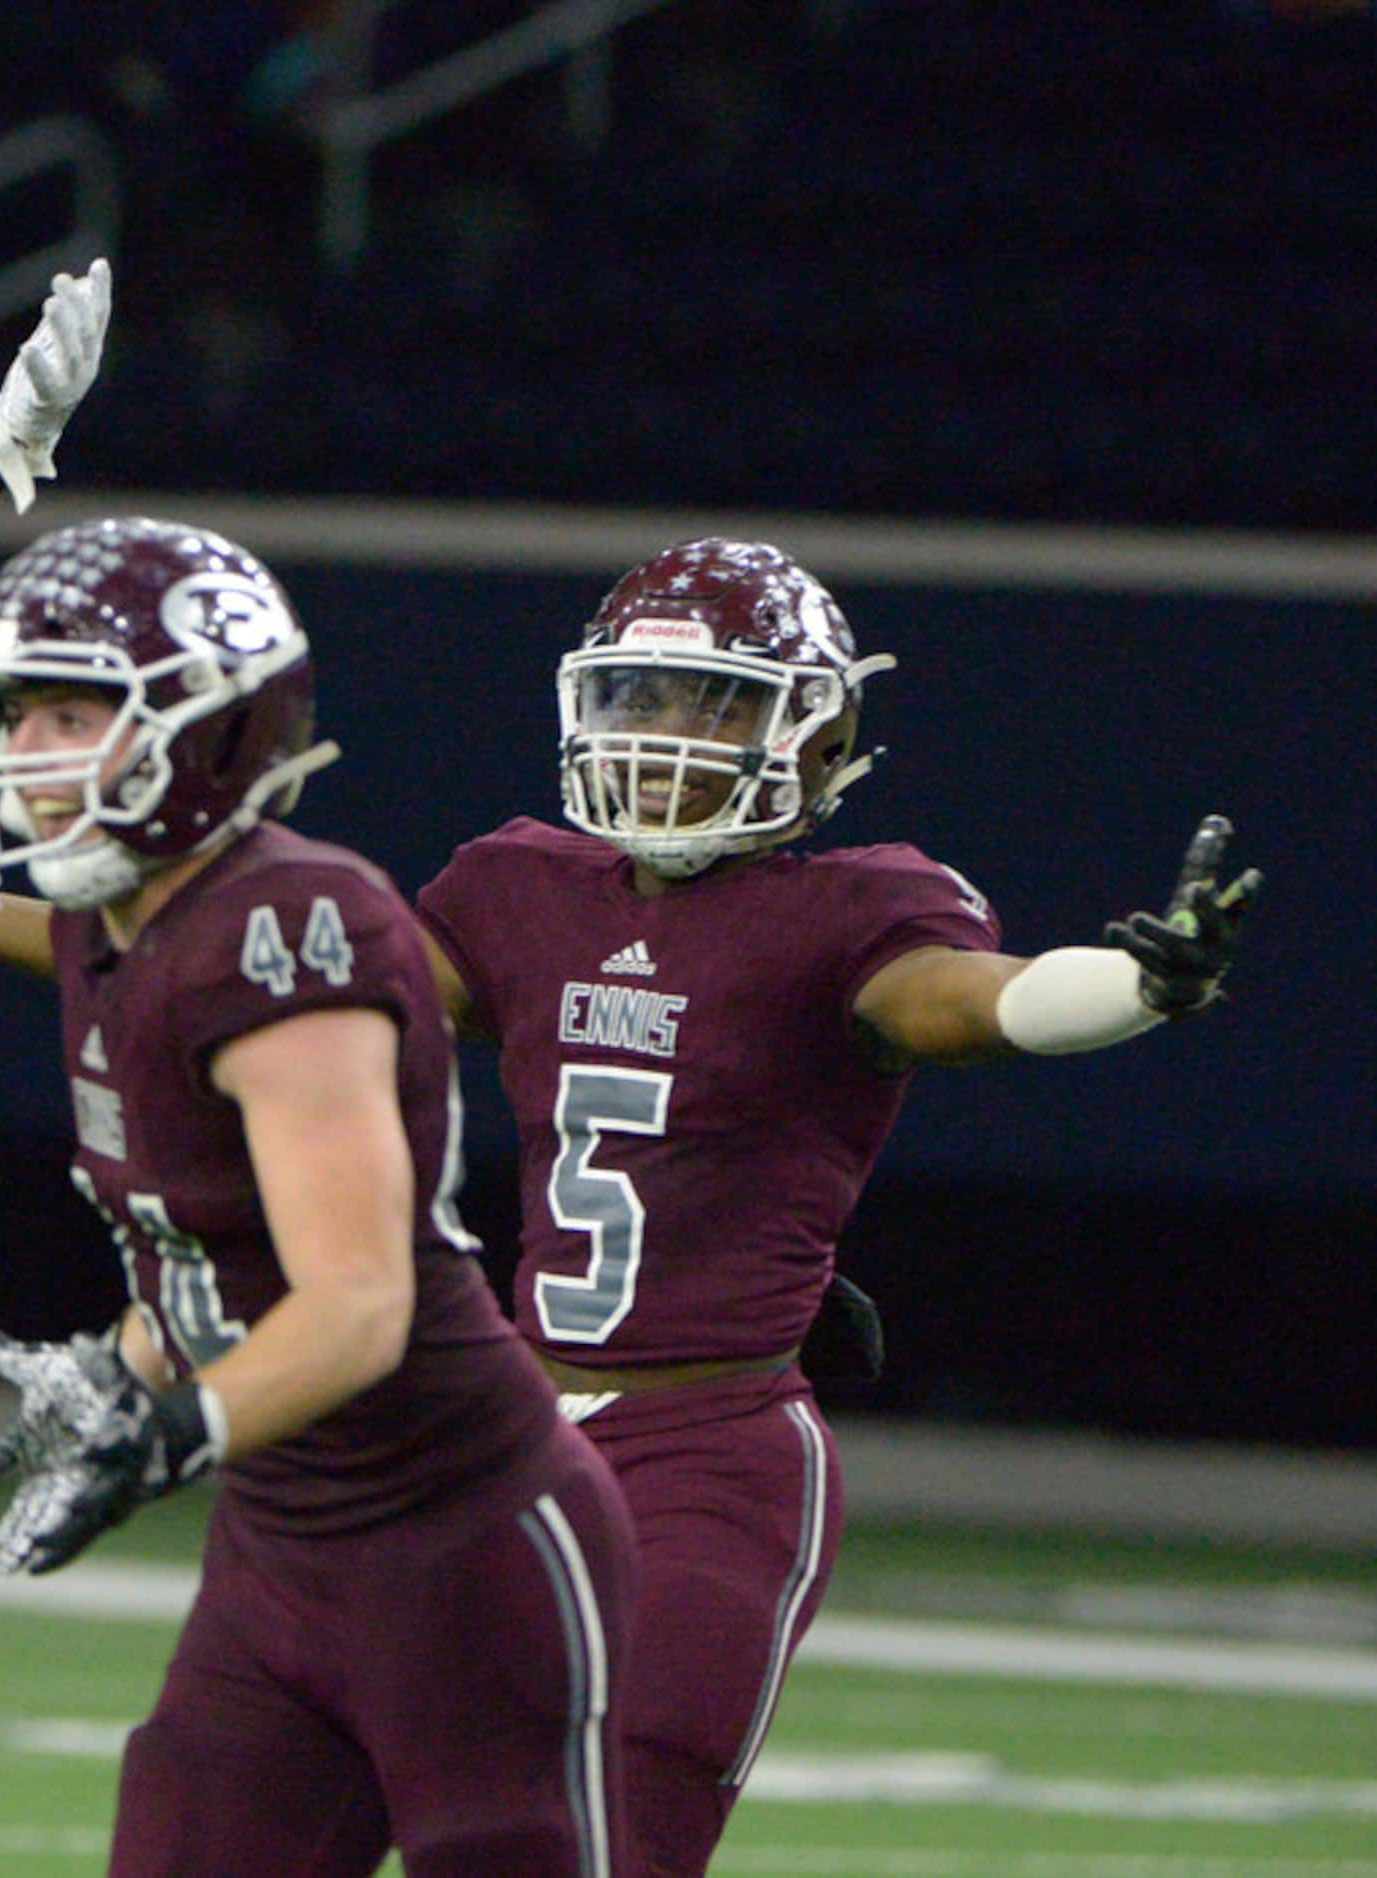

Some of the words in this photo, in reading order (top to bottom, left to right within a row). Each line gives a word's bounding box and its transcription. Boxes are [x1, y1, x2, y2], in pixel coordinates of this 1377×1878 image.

[240, 896, 354, 998] 44
[558, 980, 690, 1059] ENNIS
[533, 1062, 675, 1346] 5
